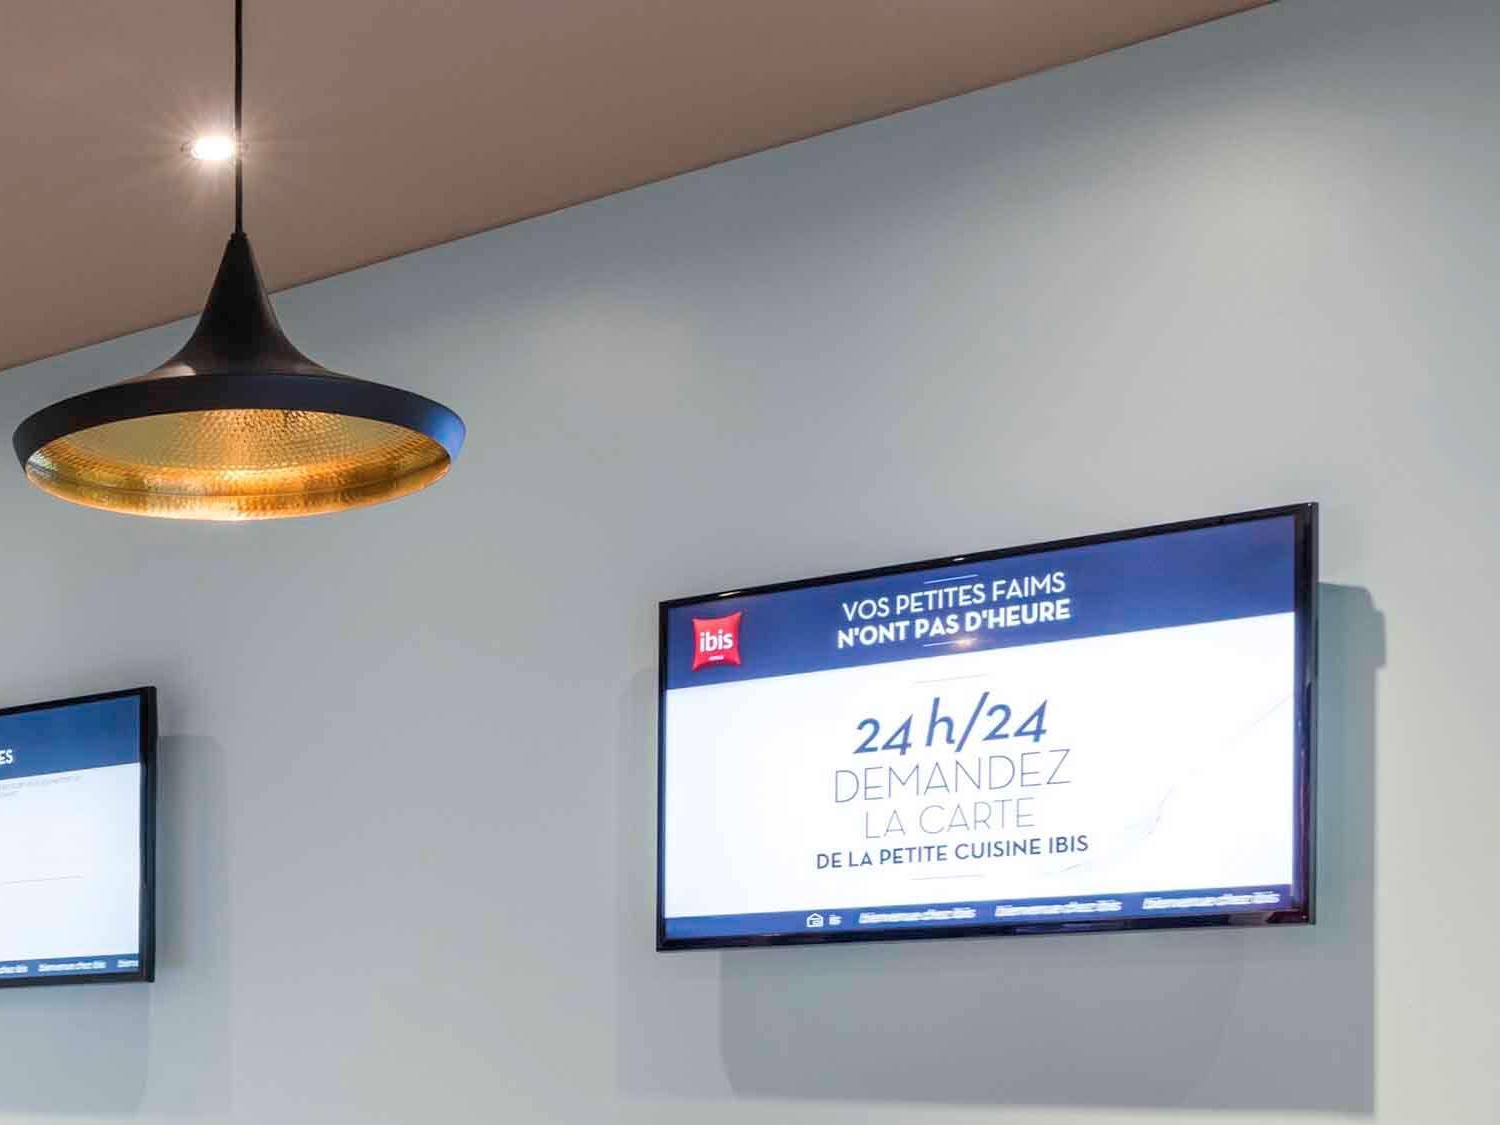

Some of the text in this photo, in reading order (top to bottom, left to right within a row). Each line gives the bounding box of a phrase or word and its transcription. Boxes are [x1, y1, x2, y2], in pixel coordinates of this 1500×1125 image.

[842, 571, 1066, 622] VOS PETITES FAIMS
[699, 627, 734, 653] ibis
[837, 597, 1071, 649] N'ONT PAS D'HEURE
[834, 748, 1072, 803] DEMANDEZ
[865, 796, 1036, 839] LA CARTE
[816, 834, 1089, 869] DE LA PETITE CUISINE IBIS
